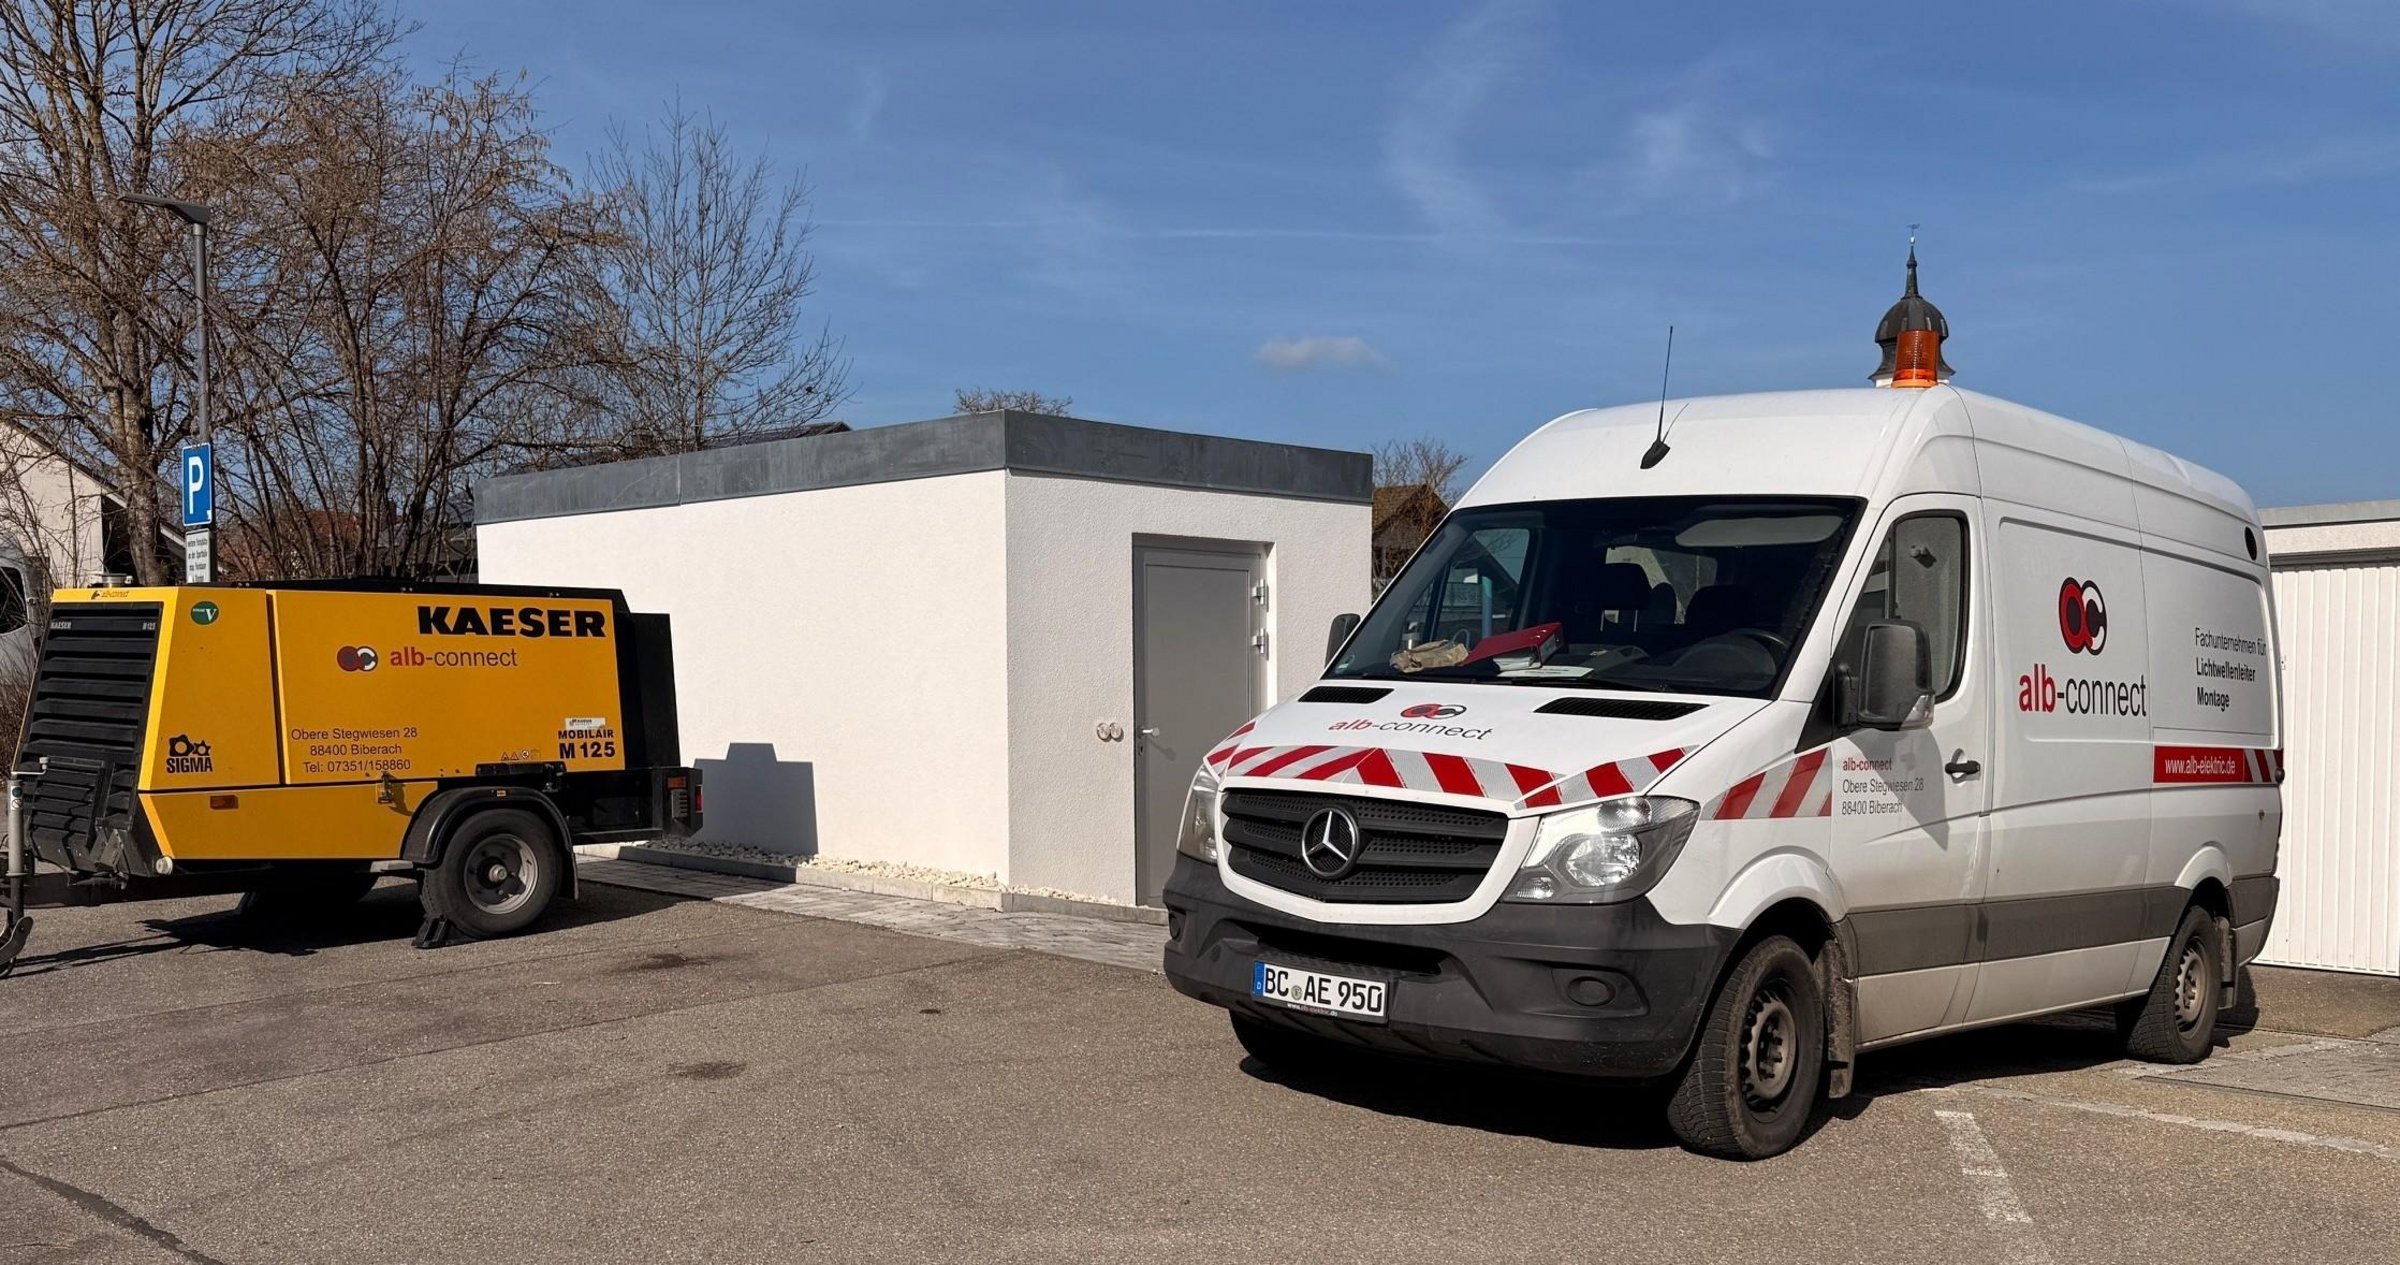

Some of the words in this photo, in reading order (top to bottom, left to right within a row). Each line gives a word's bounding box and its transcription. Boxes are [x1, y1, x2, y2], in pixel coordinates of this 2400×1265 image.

[188, 456, 204, 515] P
[418, 606, 606, 637] KAESER
[2195, 627, 2257, 655] Fachunternehmen
[2257, 638, 2267, 656] für
[390, 646, 518, 667] alb-connect
[2196, 657, 2256, 682] Lichtwellenleiter
[2018, 663, 2147, 717] alb-connect
[2197, 687, 2230, 712] Montage
[291, 729, 329, 740] Obere
[332, 728, 400, 741] Stegwiesen
[403, 727, 418, 738] 28
[558, 729, 614, 739] MOBILAIR
[1328, 718, 1493, 740] alb-connect
[310, 745, 347, 756] 88400
[351, 744, 402, 755] Biberach
[559, 742, 576, 759] M
[580, 742, 616, 758] 125
[166, 757, 213, 774] SIGMA
[304, 761, 324, 773] Tel:
[327, 759, 411, 772] 07351/158860
[1843, 758, 1892, 771] alb-connect
[2165, 755, 2236, 775] www.alb-elektric.de
[1842, 779, 1868, 793] Obere
[1870, 779, 1914, 795] Stegwiesen
[1914, 777, 1925, 791] 28
[1842, 801, 1867, 815] 88400
[1869, 799, 1902, 814] Biberach
[1265, 968, 1289, 996] BC
[1304, 976, 1332, 1005] AE
[1338, 981, 1383, 1012] 950
